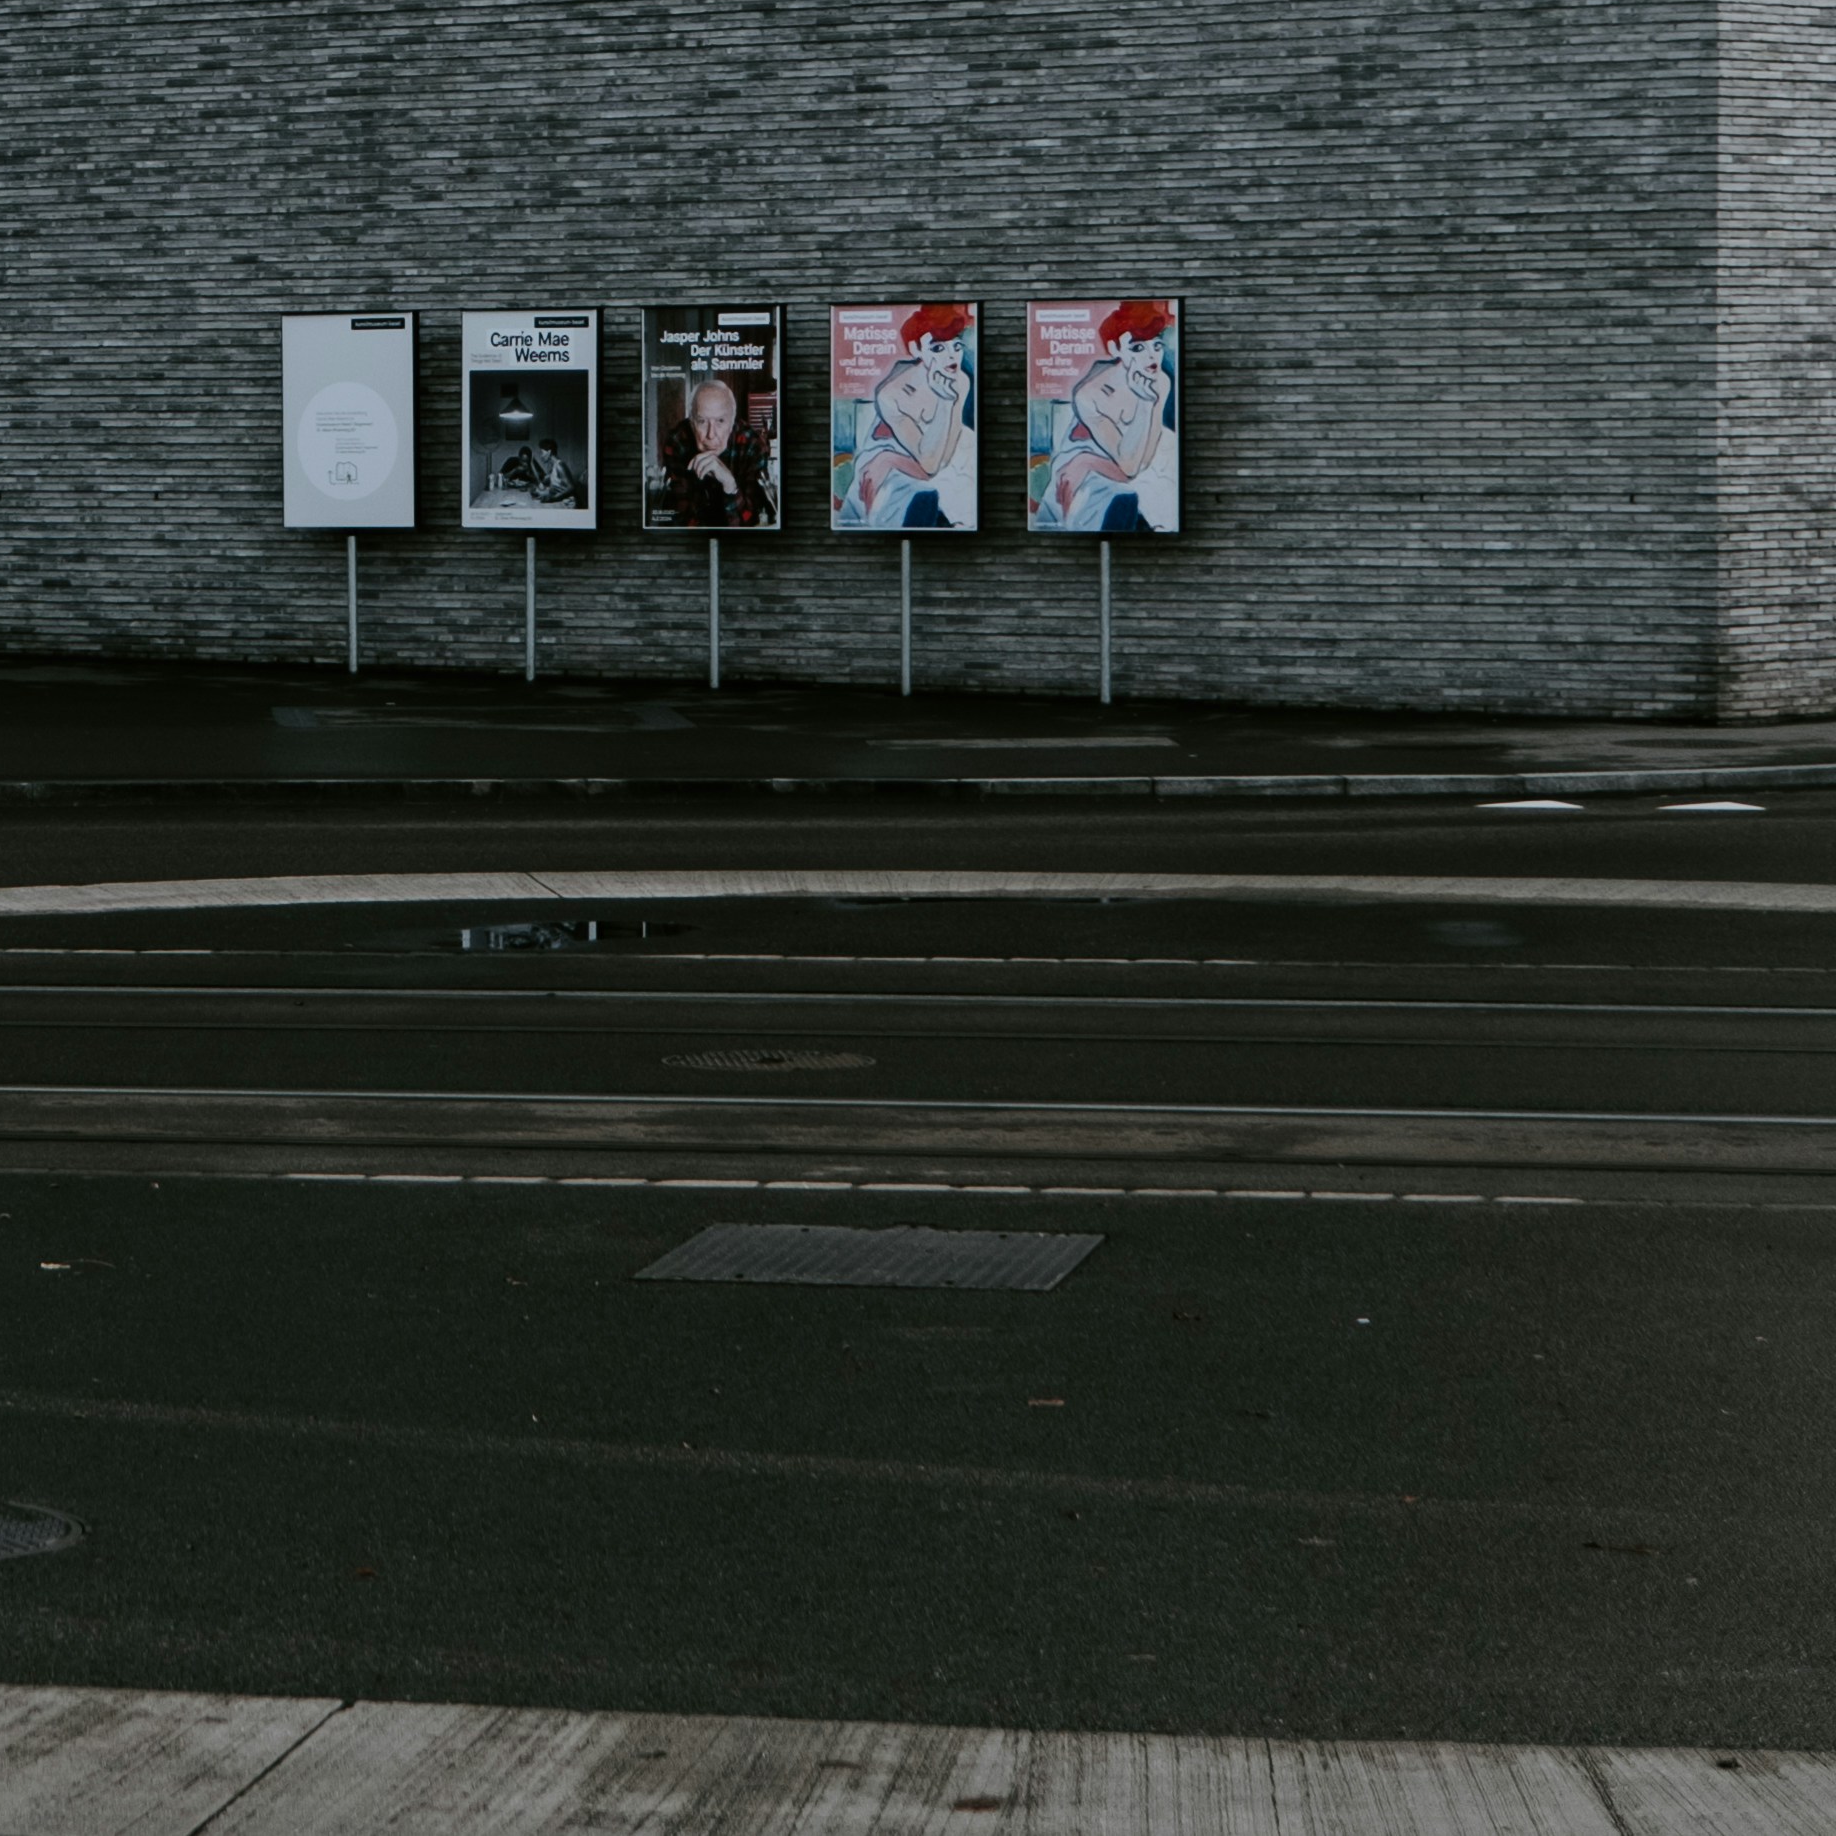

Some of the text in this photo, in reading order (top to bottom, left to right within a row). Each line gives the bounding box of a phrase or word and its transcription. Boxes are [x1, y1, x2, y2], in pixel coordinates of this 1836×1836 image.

[490, 331, 570, 347] Carrie Mae
[660, 329, 740, 345] Jasper Johns
[843, 326, 897, 340] Matisse
[1040, 325, 1096, 340] Matisse
[690, 343, 765, 356] Der Künstler
[852, 341, 897, 355] Derain
[1050, 340, 1095, 355] Derain
[515, 348, 570, 363] Weems
[839, 357, 856, 366] und
[1035, 357, 1053, 366] und
[691, 357, 765, 370] als Sammler
[845, 366, 881, 376] Freunde
[1041, 367, 1079, 376] Freunde
